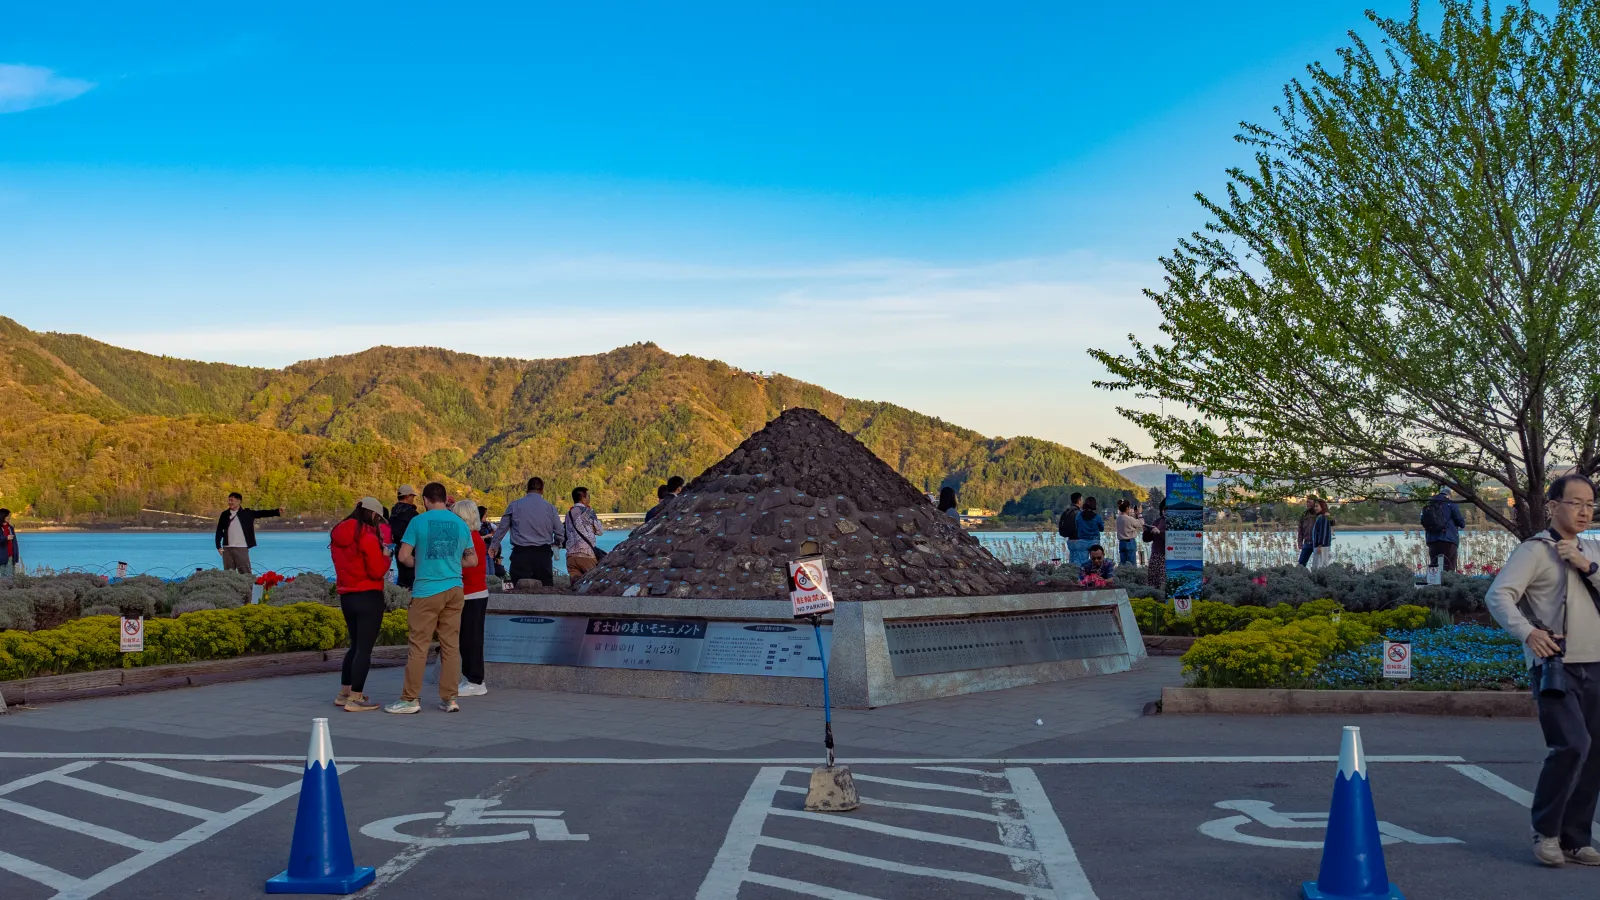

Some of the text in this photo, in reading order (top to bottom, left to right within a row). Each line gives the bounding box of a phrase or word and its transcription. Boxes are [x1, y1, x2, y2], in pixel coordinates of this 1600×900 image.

[796, 592, 827, 605] 駐輪禁止
[806, 602, 830, 610] PARKING
[593, 621, 700, 636] 富士山の集いモニュメント
[594, 643, 681, 657] 富士山の日 2月23日
